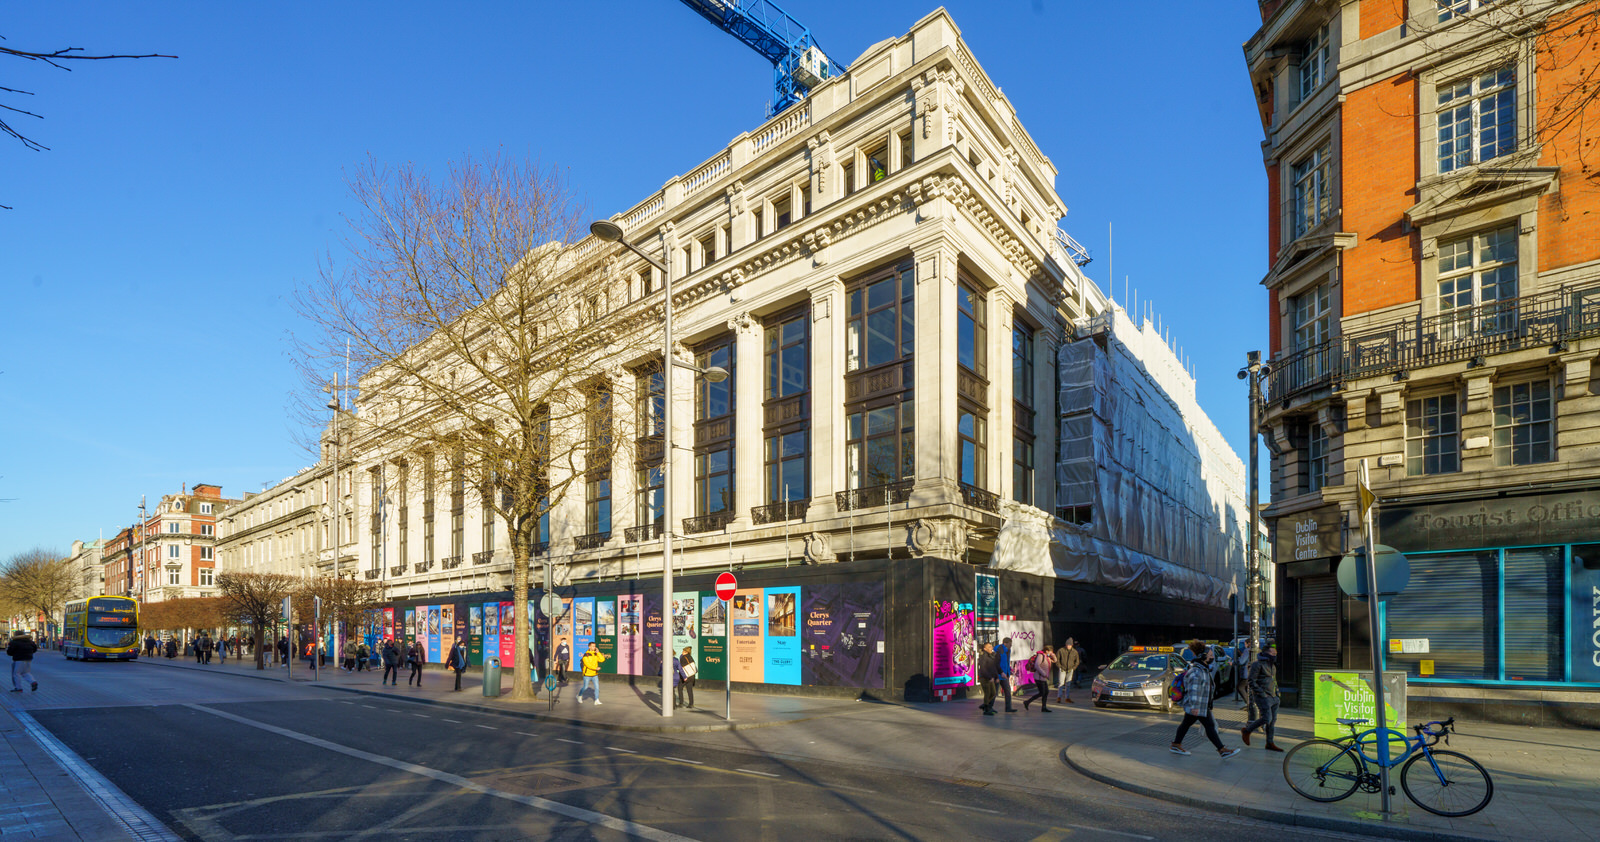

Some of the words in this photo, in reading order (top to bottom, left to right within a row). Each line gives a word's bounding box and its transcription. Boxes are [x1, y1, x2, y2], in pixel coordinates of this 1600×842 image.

[1414, 507, 1516, 529] Tourist
[1295, 518, 1318, 533] Dublin
[1295, 532, 1318, 547] Visitor
[1295, 546, 1318, 560] Centre
[810, 611, 830, 620] Clerys
[646, 620, 664, 628] Quarter
[807, 619, 833, 627] Quarter
[705, 656, 721, 664] Clerys
[1343, 689, 1375, 703] Dublin
[1343, 701, 1375, 714] Visitor
